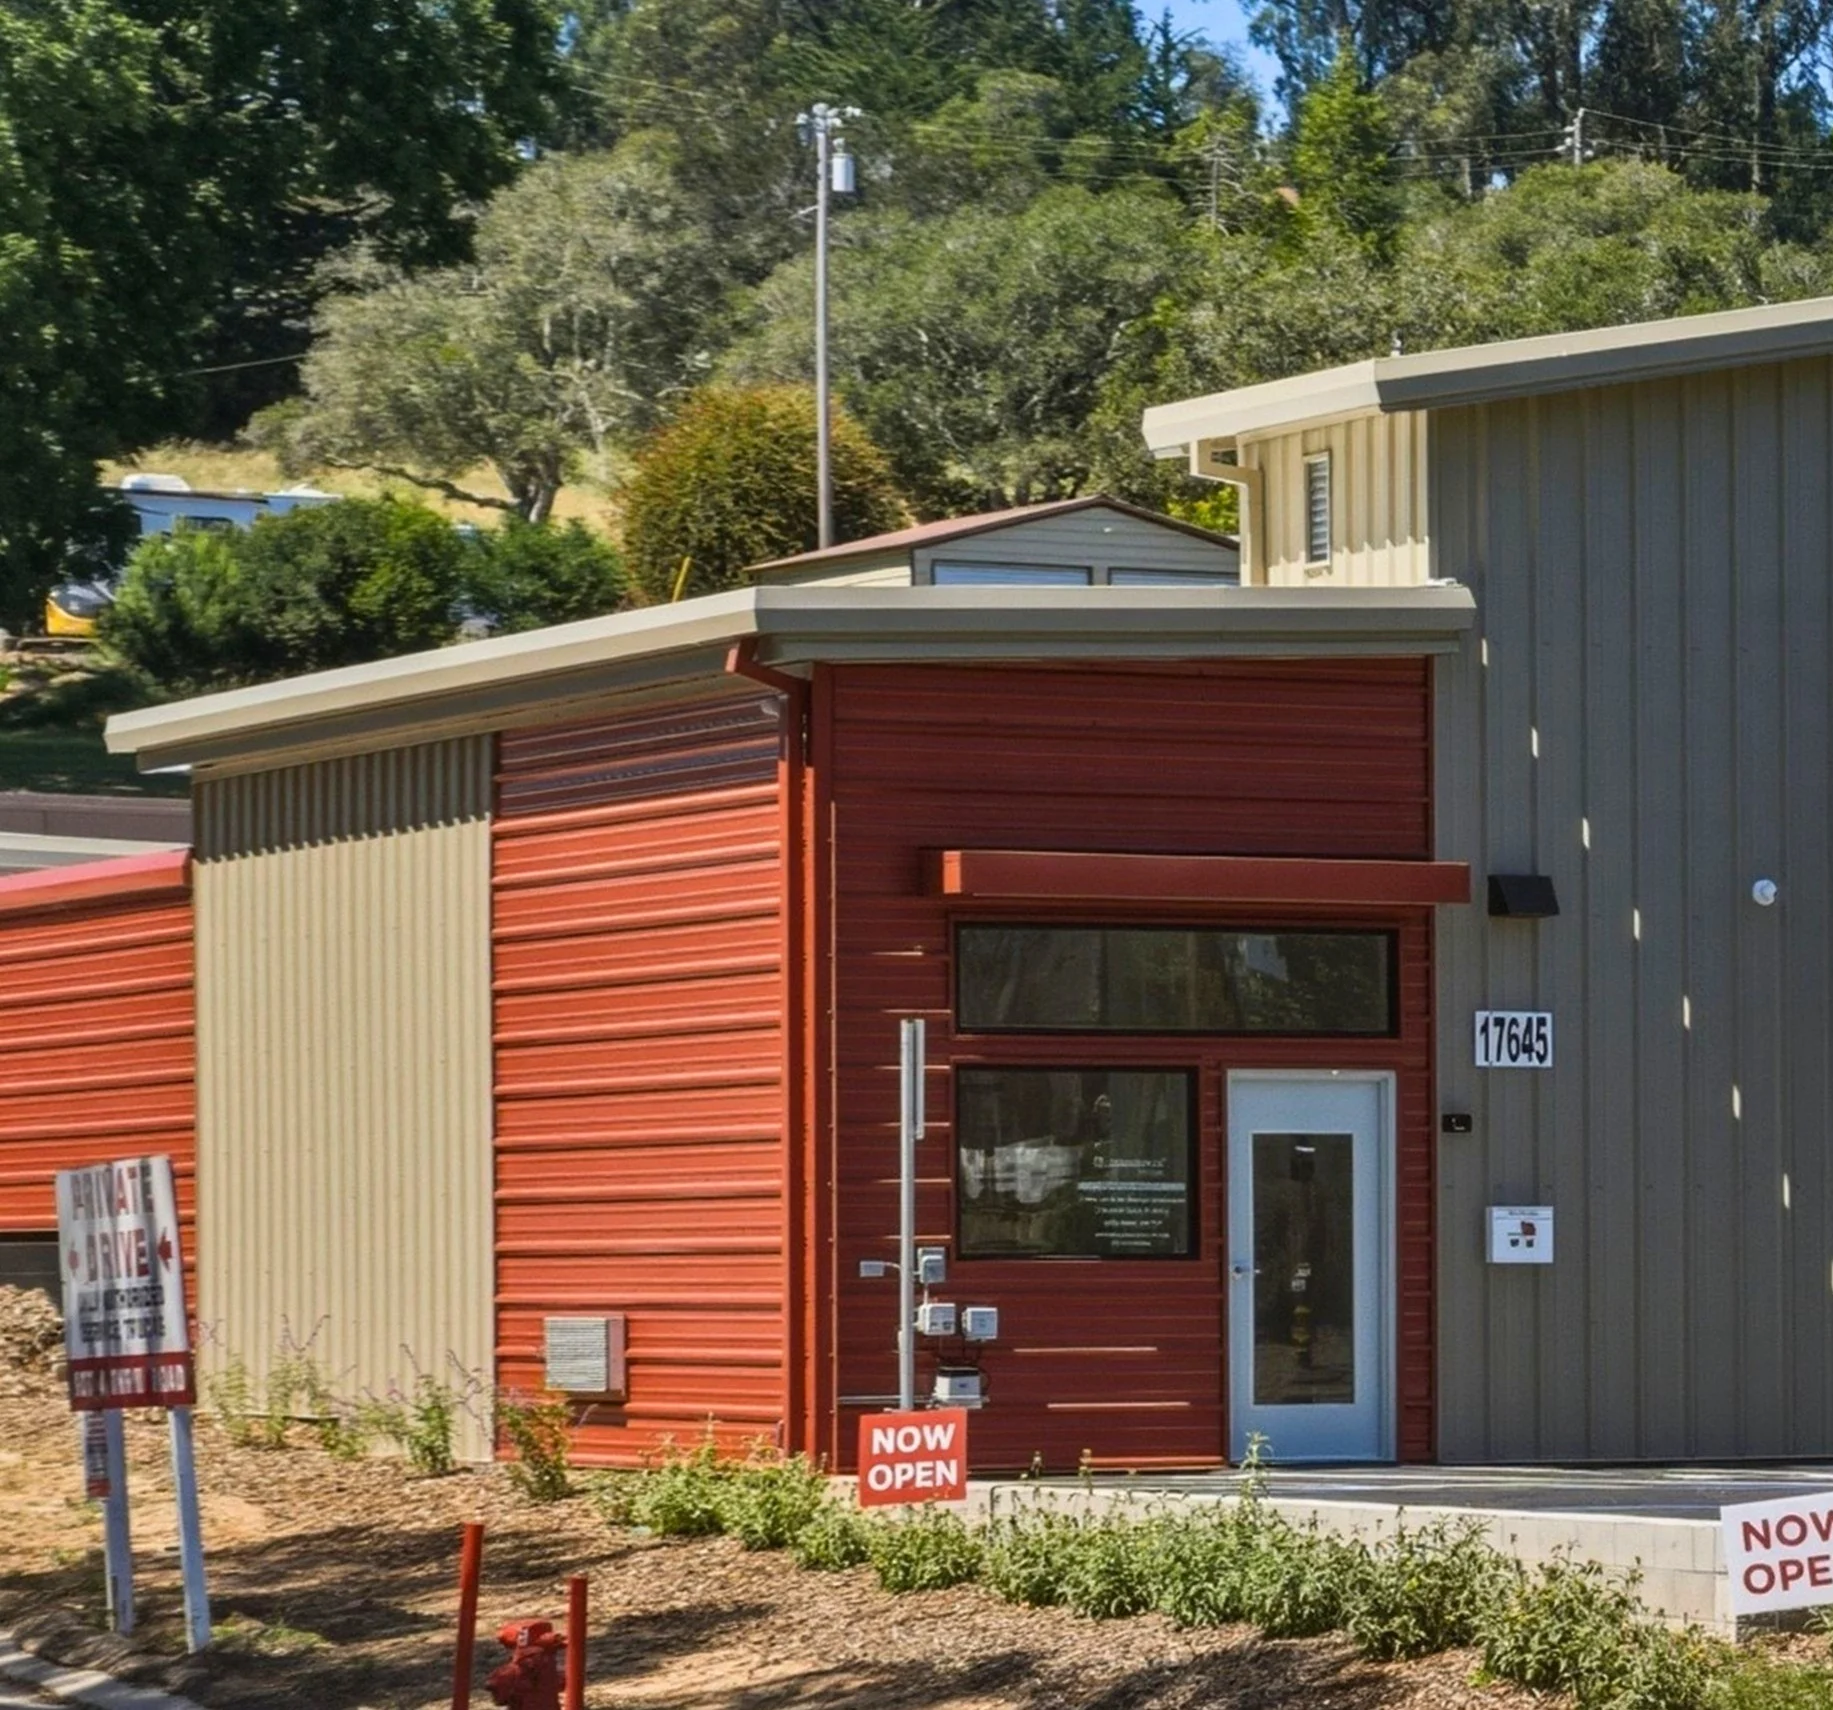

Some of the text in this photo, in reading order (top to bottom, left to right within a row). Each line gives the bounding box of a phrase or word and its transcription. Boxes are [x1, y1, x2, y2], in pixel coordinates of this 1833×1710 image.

[1480, 1016, 1549, 1064] 17645
[70, 1158, 154, 1221] PRIVATE
[85, 1227, 150, 1283] DRIVE
[871, 1423, 957, 1456] NOW
[867, 1459, 958, 1492] OPEN
